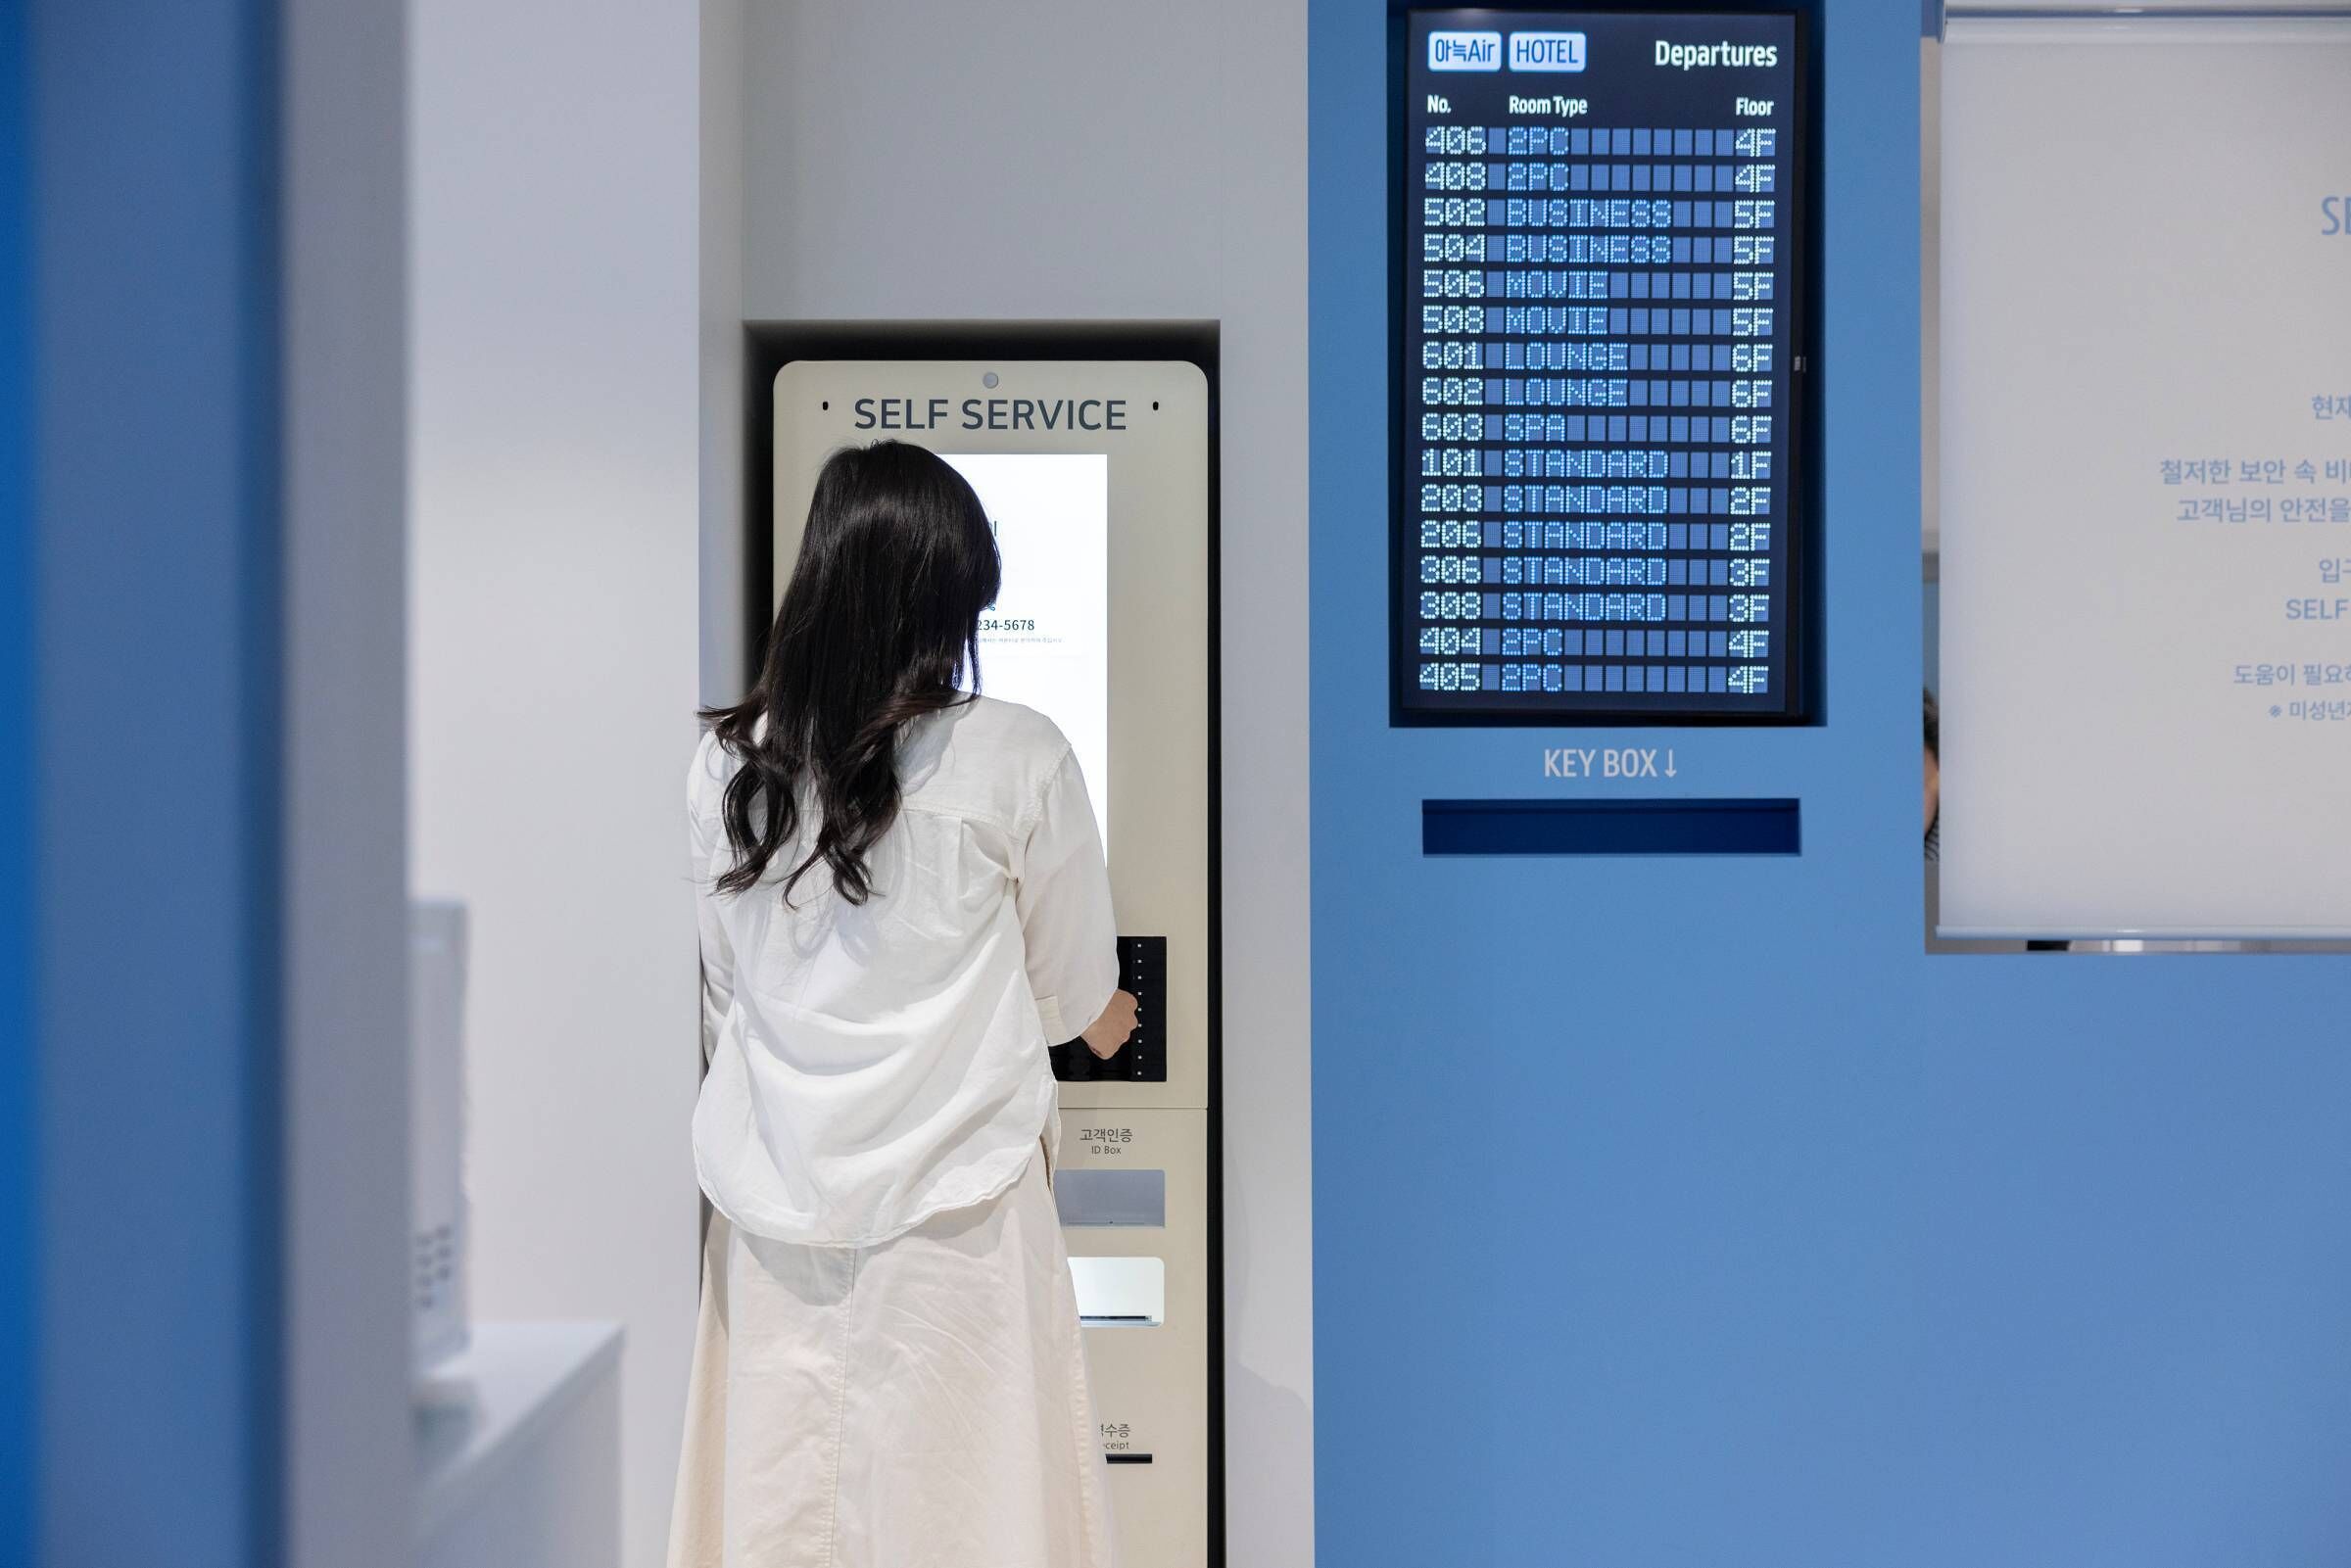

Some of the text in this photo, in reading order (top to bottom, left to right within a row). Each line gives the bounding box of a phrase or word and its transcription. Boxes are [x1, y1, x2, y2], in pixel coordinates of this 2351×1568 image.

[1516, 39, 1579, 64] HOTEL
[1655, 39, 1778, 71] Departures
[1426, 94, 1774, 119] No. Room Type Floor
[1425, 126, 1775, 157] 406 2PC 4F
[1425, 163, 1775, 193] 408 2PC 4F
[1424, 198, 1775, 228] 502 BUSINESS 5F
[1424, 234, 1774, 264] 504 BUSINESS 5F
[1423, 269, 1774, 300] 506 MOVIE 5F
[1423, 306, 1773, 336] 508 MOVIE 5F
[1423, 341, 1773, 371] 601 LOUNGE 6F
[1422, 377, 1772, 407] 602 LOUNGE 6F
[854, 399, 1127, 430] SELF SERVICE
[1422, 412, 1772, 443] 603 SPA 6F
[1421, 449, 1771, 479] 101 STANDARD 1F
[2160, 459, 2351, 485] 철저한 보안 속 비
[1421, 484, 1771, 514] 203 STANDARD 2F
[2177, 498, 2351, 523] 고객님의 안전을
[1421, 520, 1770, 550] 206 STANDARD 2F
[1420, 555, 1770, 586] 306 STANDARD 3F
[1420, 592, 1769, 622] 308 STANDARD 3F
[2285, 598, 2349, 620] SELF
[1419, 627, 1769, 657] 404 2PC 4F
[1419, 663, 1769, 693] 405 2PC 4F
[2233, 664, 2295, 686] 도움이
[2289, 700, 2351, 721] 미성년
[1544, 748, 1657, 778] KEY BOX
[1080, 1128, 1133, 1143] 고객인증
[1091, 1145, 1122, 1155] ID Box
[1100, 1423, 1130, 1439] 수증
[1104, 1441, 1129, 1450] ceipt
